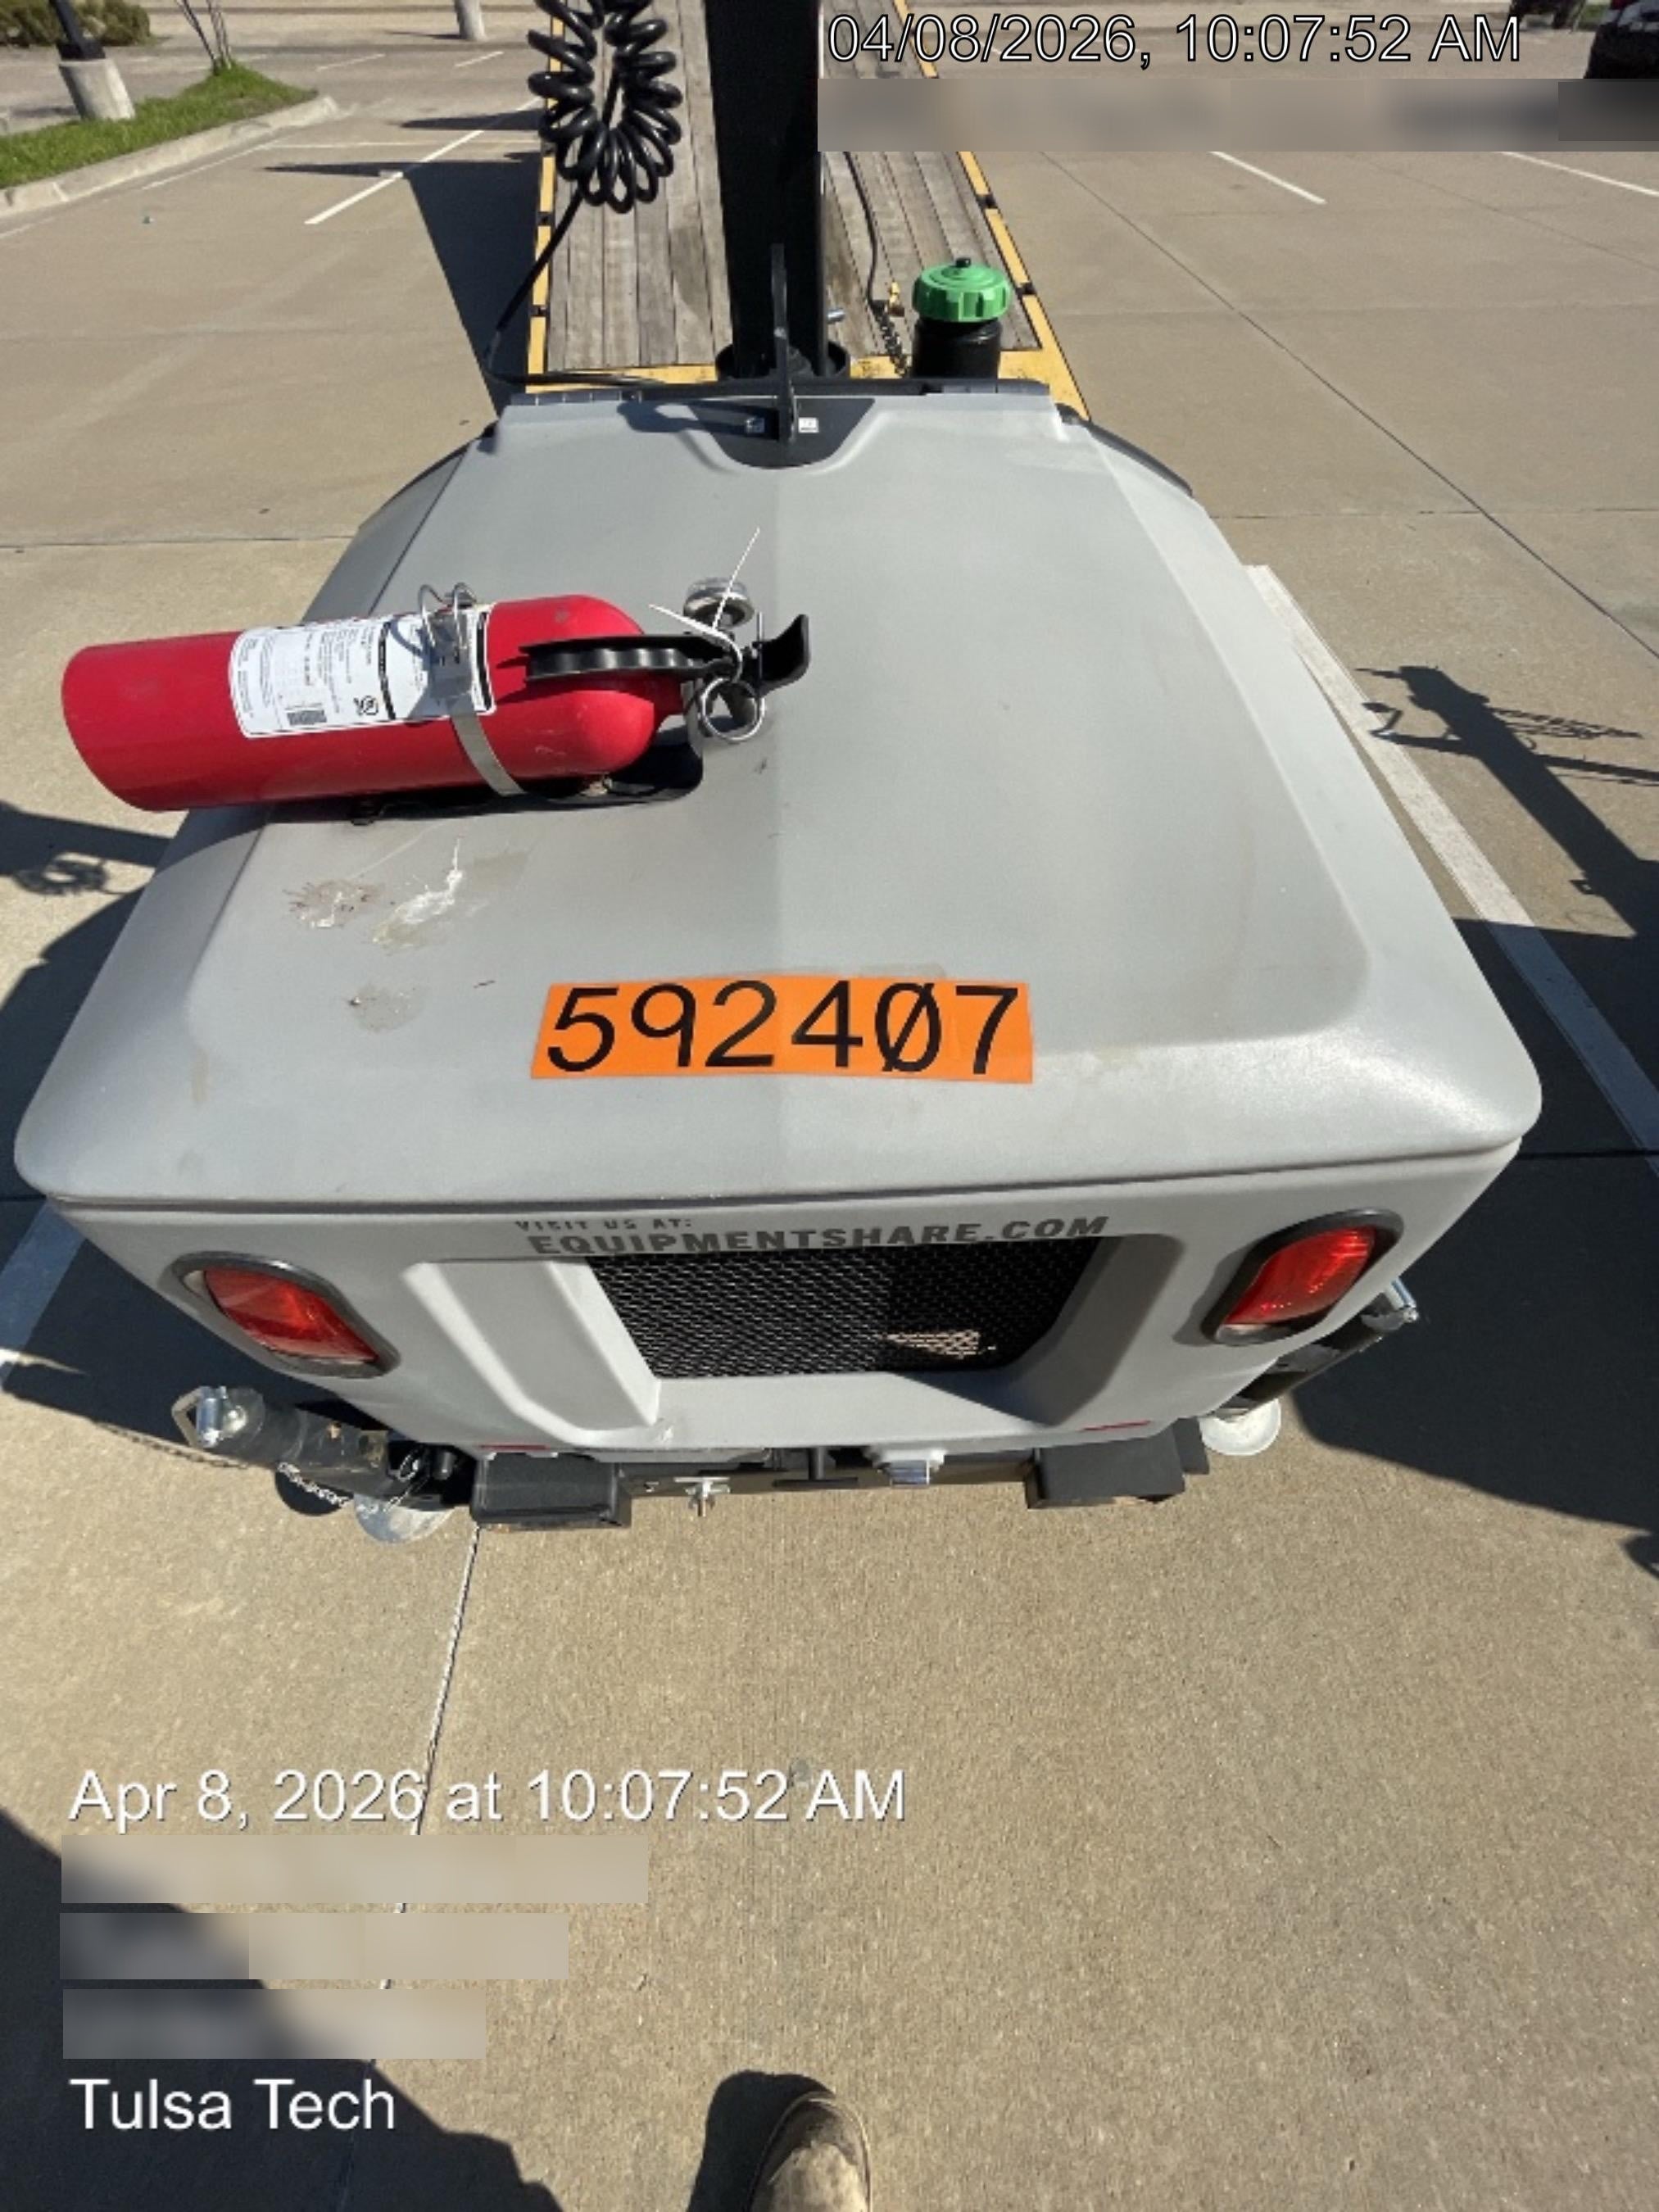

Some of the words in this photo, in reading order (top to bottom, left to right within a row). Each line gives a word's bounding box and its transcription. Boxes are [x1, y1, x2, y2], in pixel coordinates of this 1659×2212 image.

[546, 980, 1019, 1075] 592407
[514, 1220, 589, 1231] VISIT
[604, 1218, 637, 1230] US
[652, 1217, 691, 1229] AT:
[527, 1216, 1109, 1255] EQUIPMENTSHARE.COM
